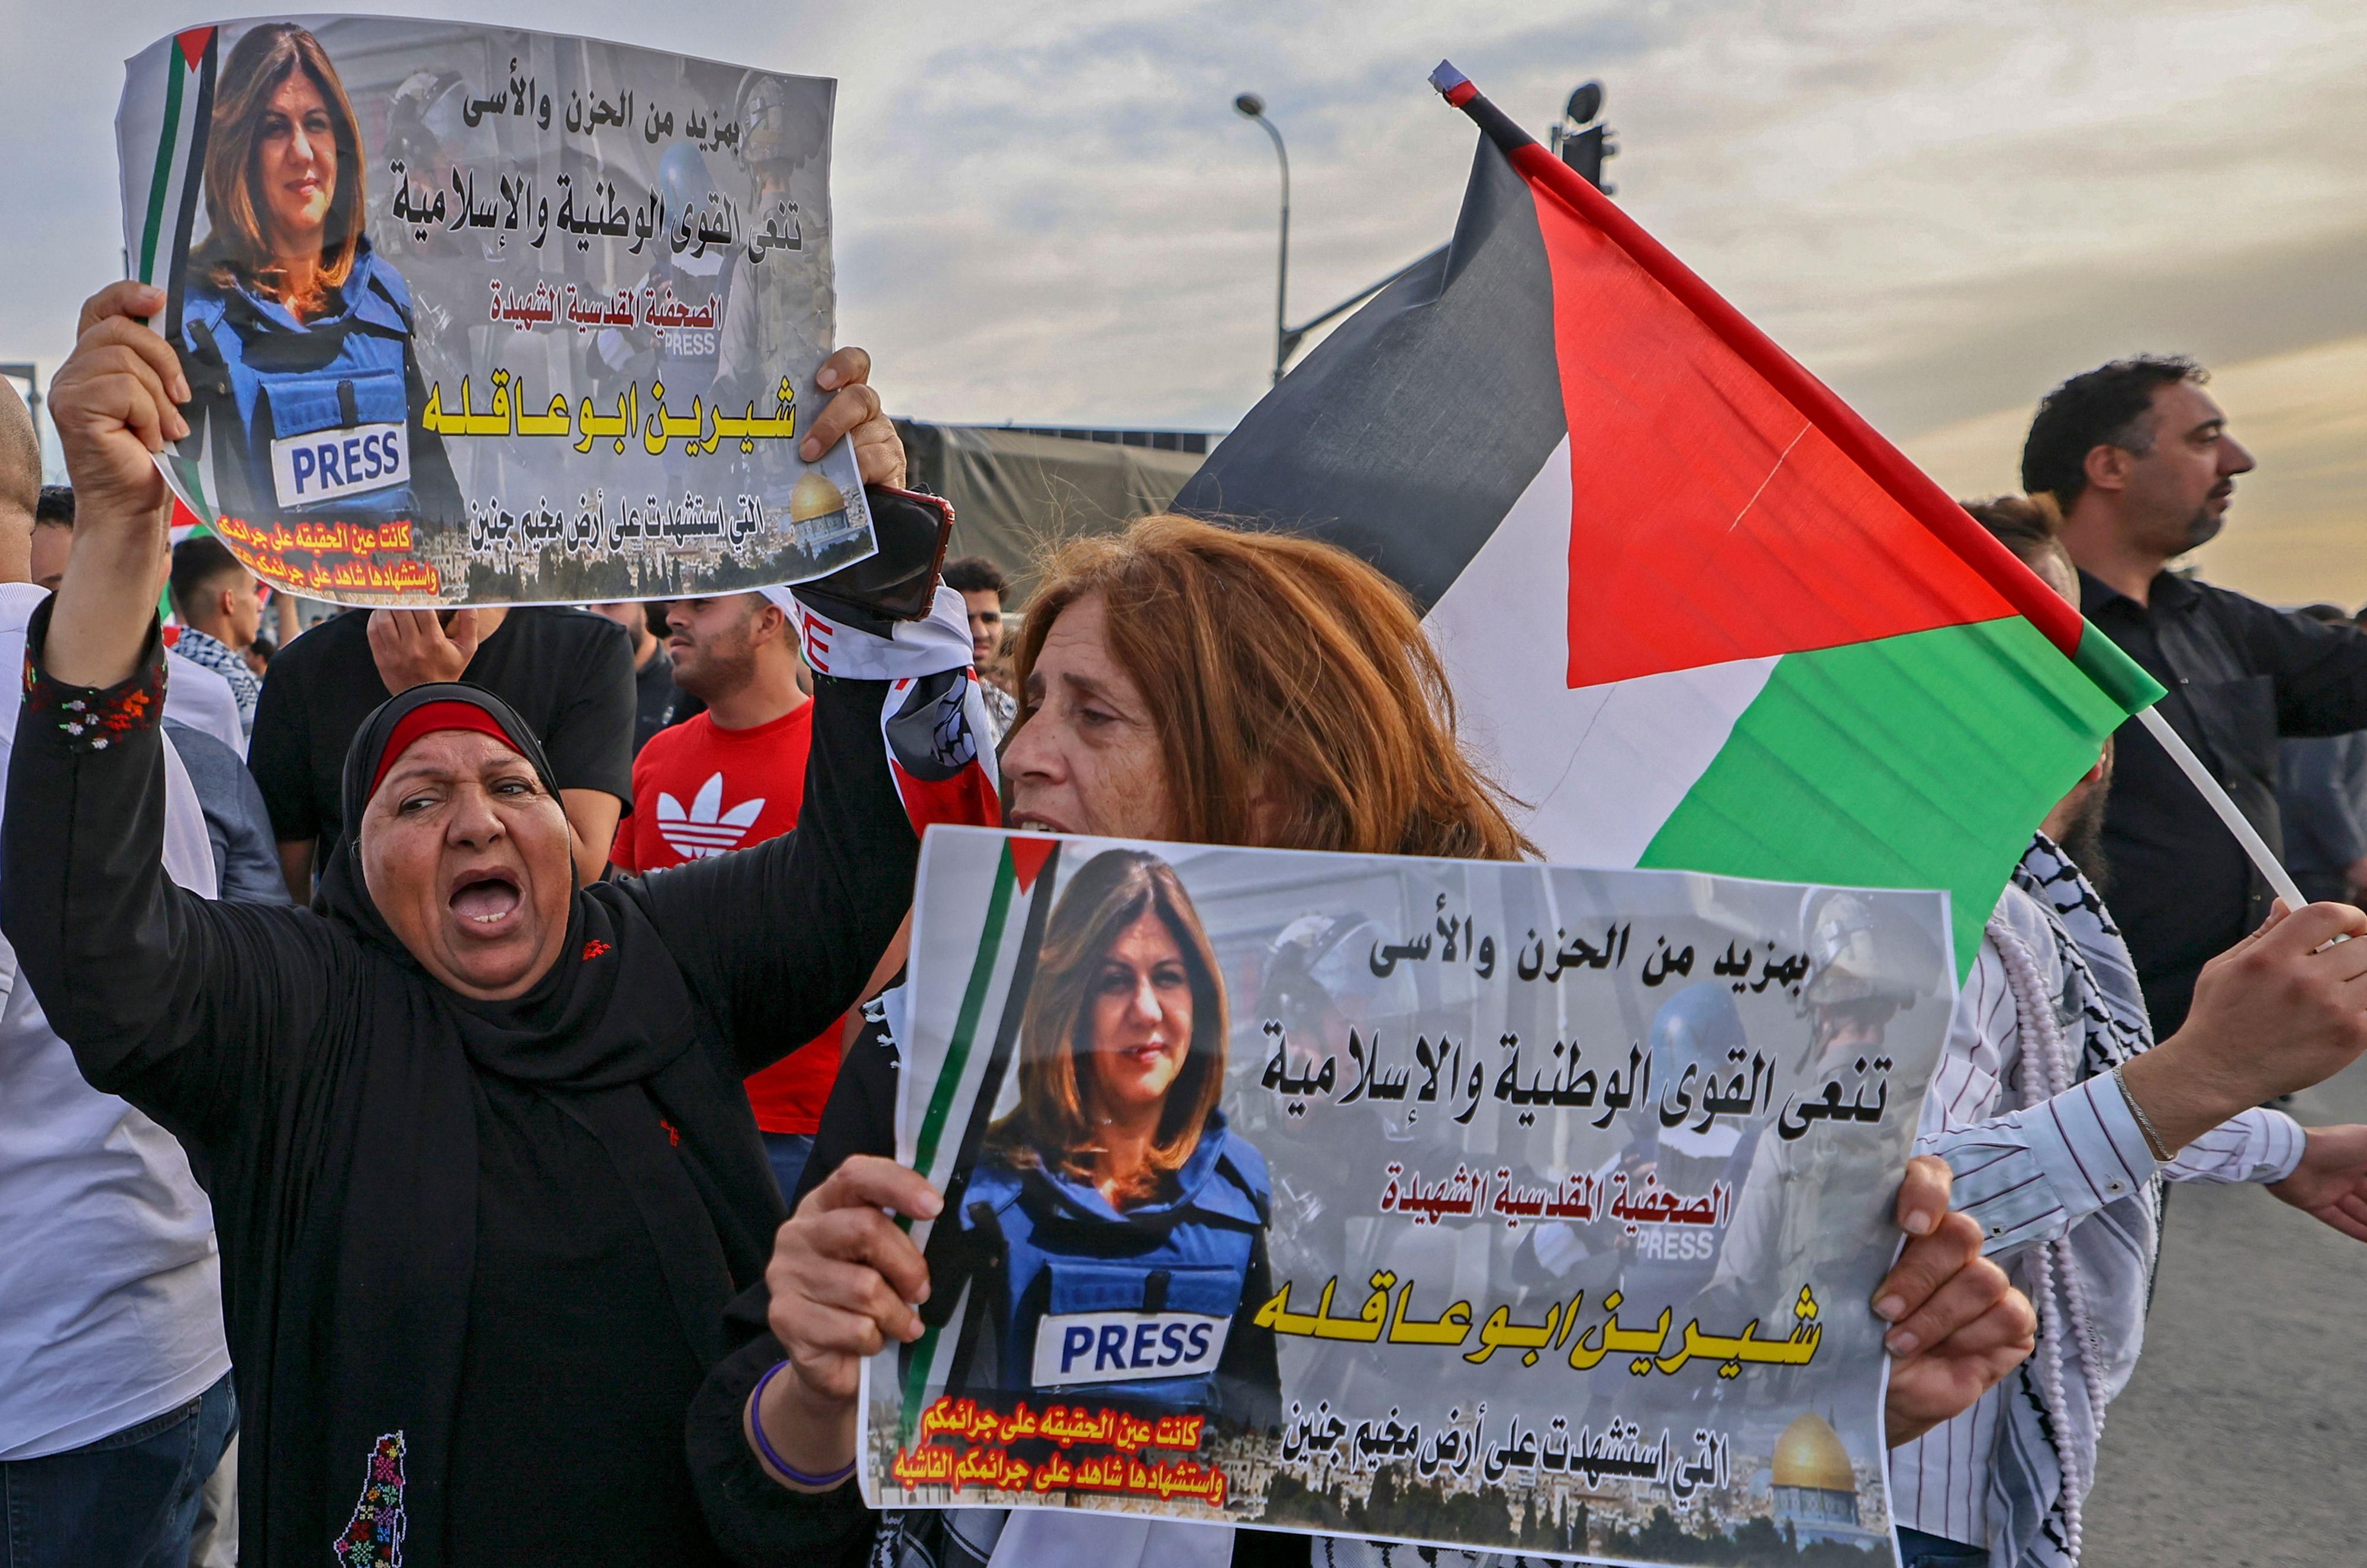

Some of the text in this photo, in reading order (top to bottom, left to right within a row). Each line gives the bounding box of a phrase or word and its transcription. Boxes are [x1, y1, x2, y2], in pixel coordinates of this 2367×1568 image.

[463, 57, 740, 154] بمزيد من الحزن والأسى
[389, 159, 803, 264] تنعى القوى الوطنية والإسلامية
[489, 279, 722, 336] الصحفية المقدسية الشهيدة
[665, 331, 715, 356] PRESS
[644, 375, 796, 456] شيرين
[292, 431, 399, 495] PRESS
[269, 523, 295, 553] على
[350, 525, 378, 556] عين
[379, 522, 411, 550] كانت
[470, 488, 765, 556] التي استشهدت على أرض مخيم جنين
[308, 561, 333, 589] على
[334, 562, 367, 588] شاهد
[366, 561, 438, 593] واستشهادها
[1369, 892, 1809, 996] بمزيد من الحزن والأسى
[1260, 1018, 1892, 1142] تنعى القوى الوطنية والإسلامية
[1379, 1163, 1731, 1236] الصحفية المقدسية الشهيدة
[1637, 1230, 1714, 1260] PRESS
[1060, 1322, 1213, 1374] PRESS
[1569, 1284, 1821, 1379] شيرين
[922, 1398, 1202, 1451] كانت عين الحقيقه على جرائمكم
[893, 1447, 1225, 1505] واستشهادها شاهد على جرائمكم الفاشيه
[1281, 1399, 1729, 1511] التي استشهدت على أرض مخيم جنين
